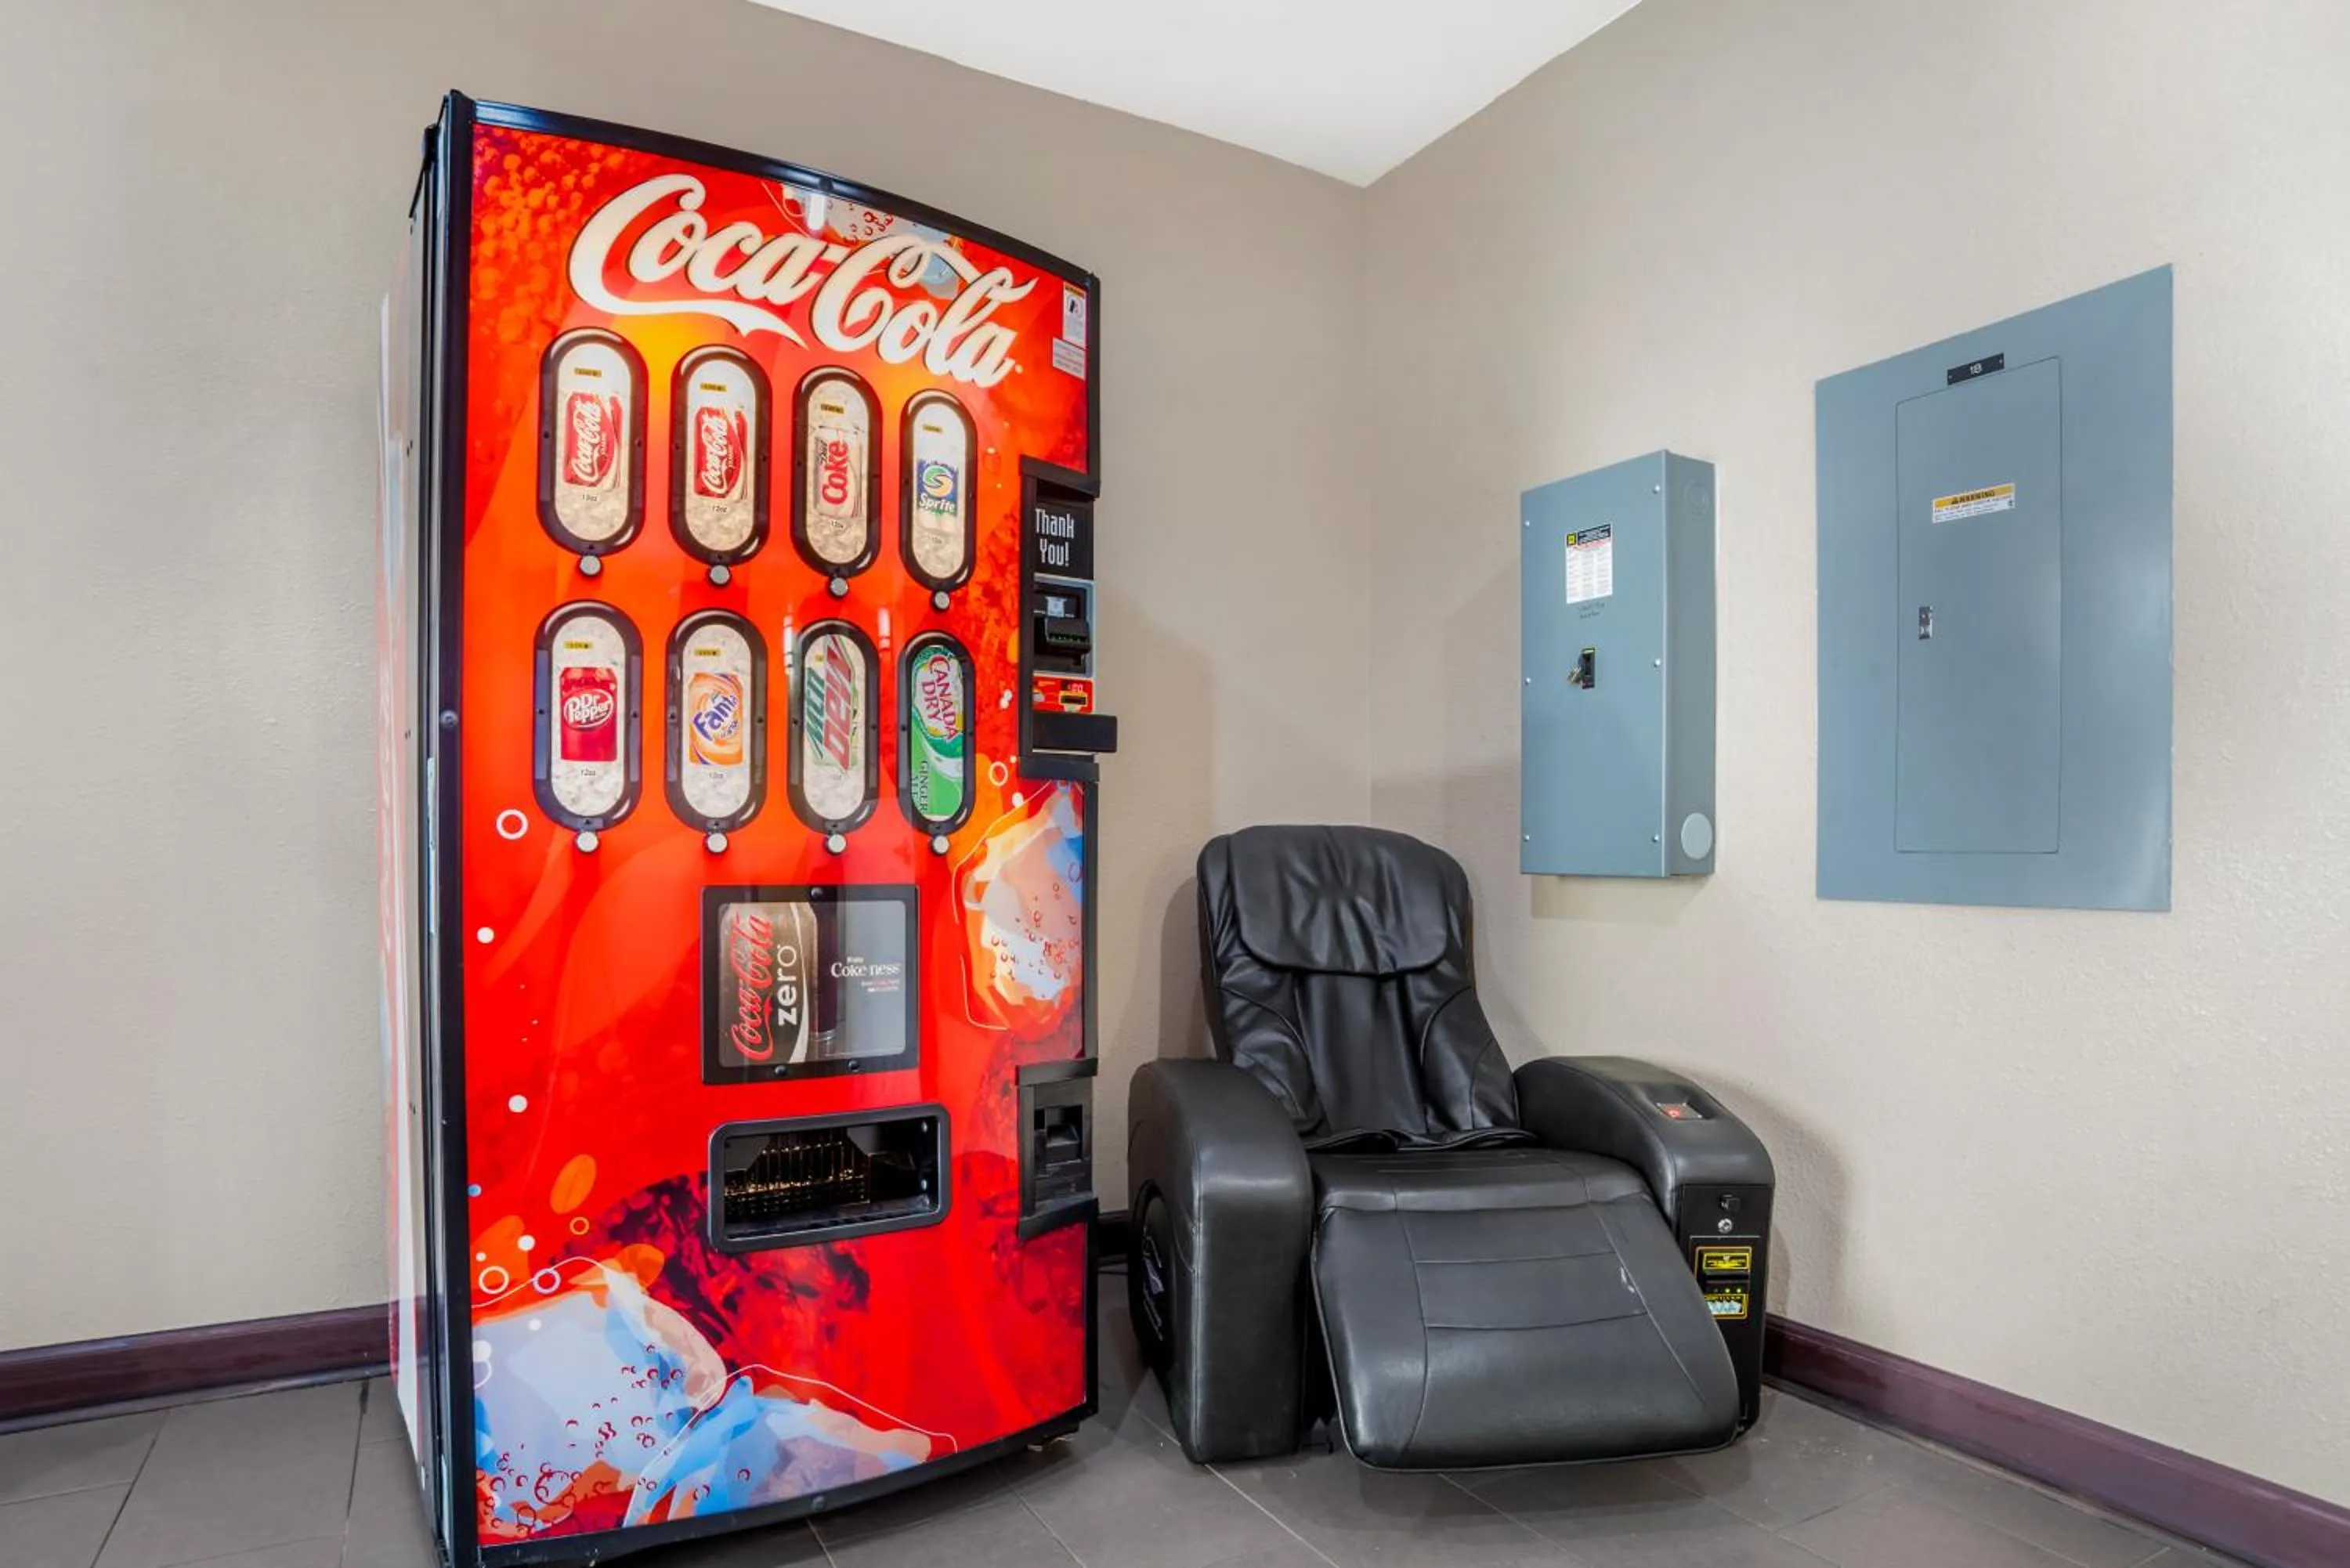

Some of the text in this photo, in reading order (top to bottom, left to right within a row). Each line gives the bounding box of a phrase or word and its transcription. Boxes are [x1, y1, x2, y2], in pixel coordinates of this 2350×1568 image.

[567, 172, 1037, 389] Coca-Cola
[822, 441, 848, 505] Coke
[919, 493, 956, 513] Sprite
[1035, 508, 1074, 539] Thank
[1039, 538, 1069, 567] You!
[568, 696, 613, 724] Pepper
[580, 693, 602, 708] Dr
[692, 694, 739, 742] Fanta
[921, 680, 942, 723] DRY
[929, 654, 959, 741] CANADA
[731, 911, 774, 1061] Coca-Cola
[776, 945, 797, 1026] zero
[831, 963, 867, 977] Coke
